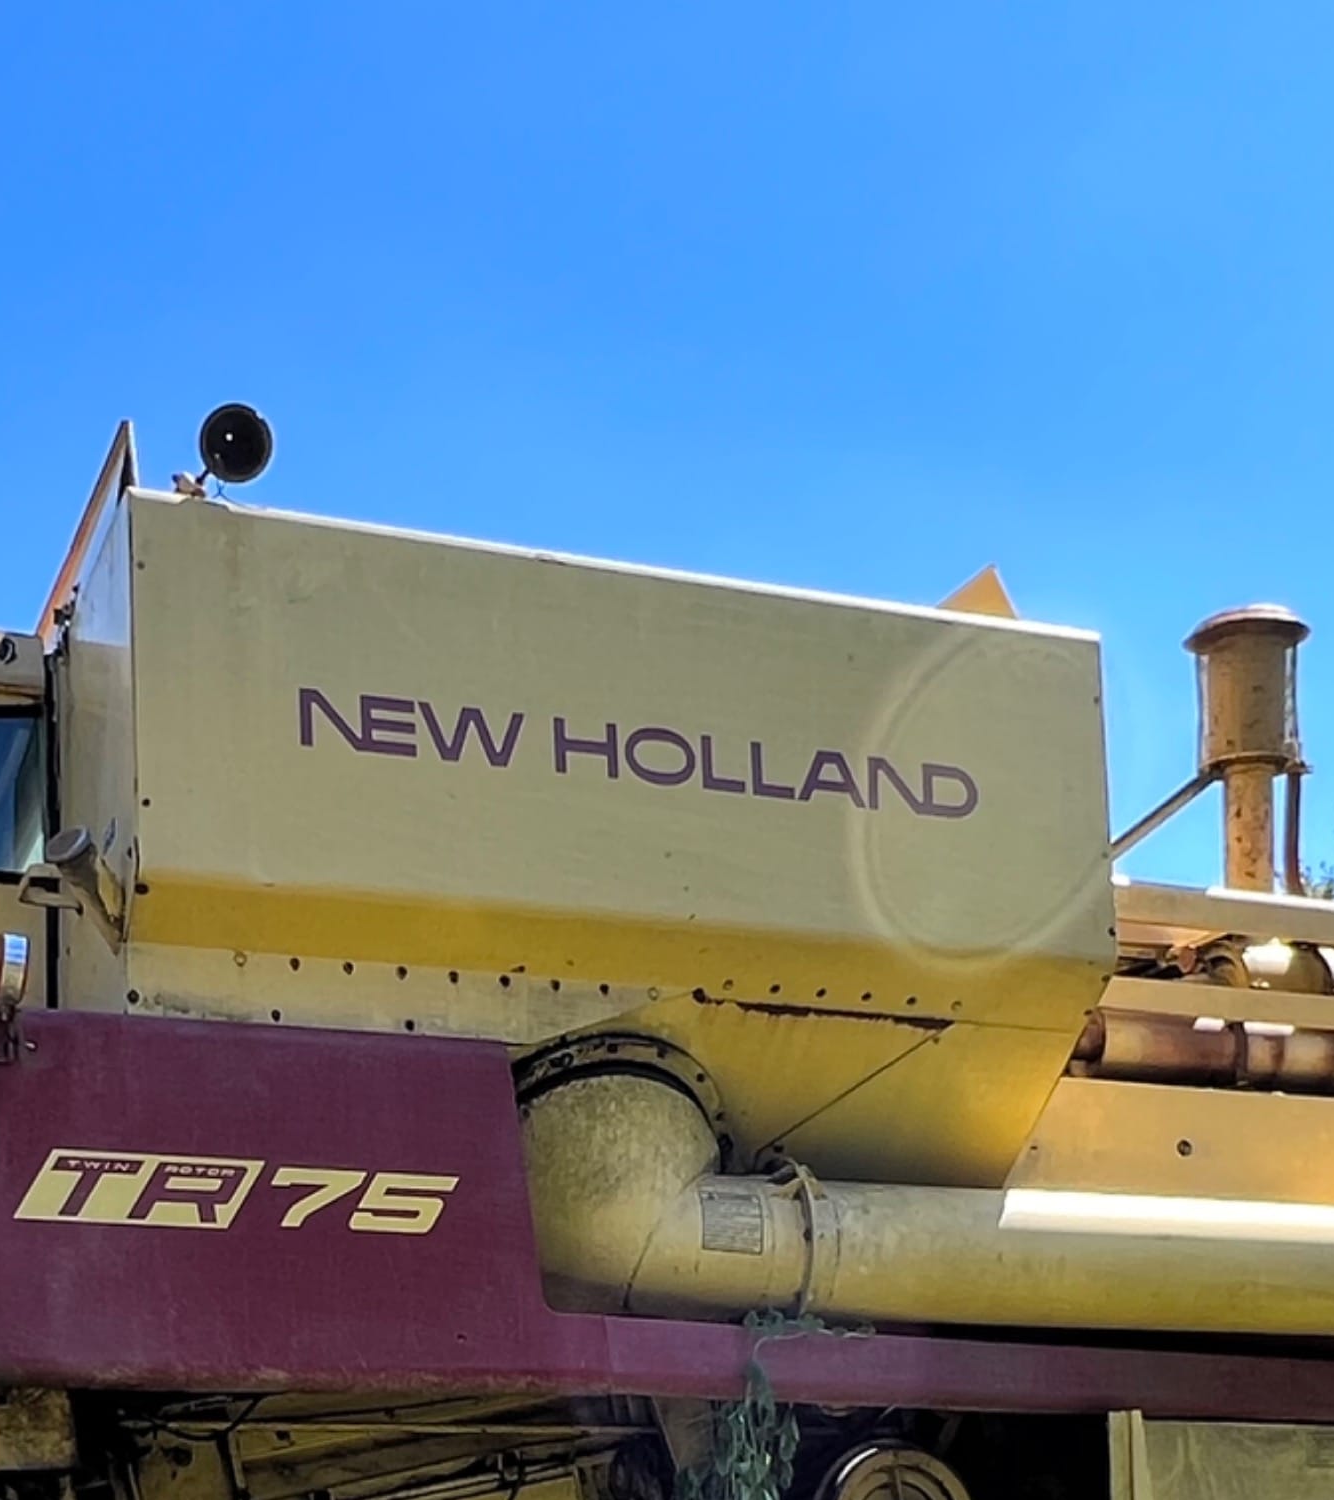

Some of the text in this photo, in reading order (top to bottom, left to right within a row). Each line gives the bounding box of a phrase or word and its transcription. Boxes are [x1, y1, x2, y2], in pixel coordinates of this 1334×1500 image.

[299, 687, 980, 819] NEW HOLLAND
[67, 1159, 236, 1177] TWIN ROTOR
[270, 1167, 460, 1235] 75
